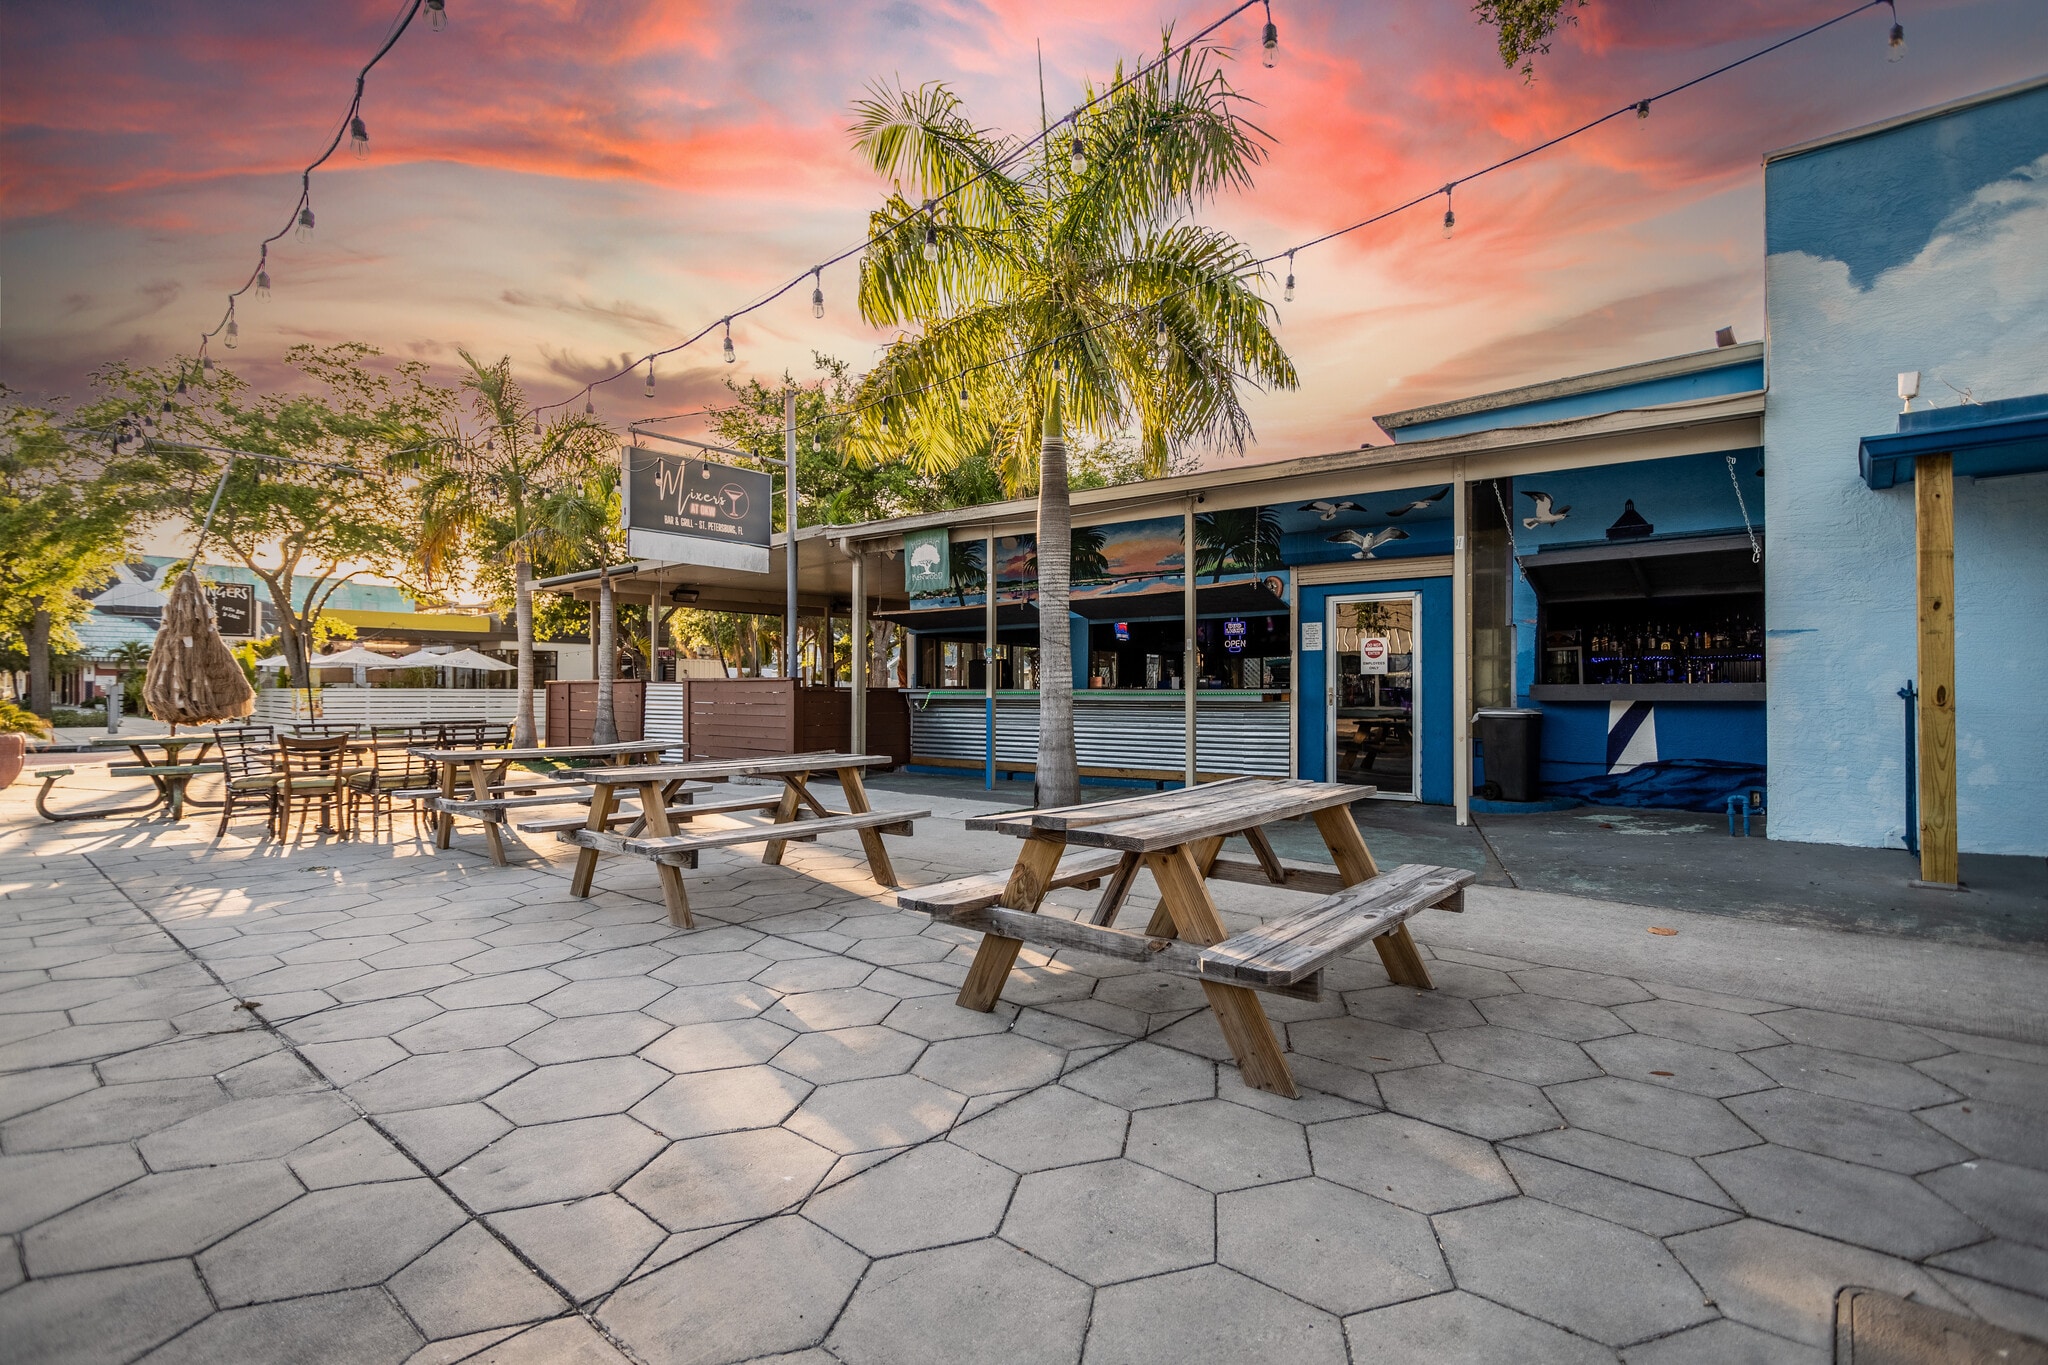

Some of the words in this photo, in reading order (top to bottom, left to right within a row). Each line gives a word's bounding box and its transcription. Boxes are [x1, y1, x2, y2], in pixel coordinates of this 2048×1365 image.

[660, 459, 726, 516] Mixers
[664, 515, 674, 525] BAR
[675, 516, 679, 526] &
[681, 517, 693, 528] GRILL
[699, 520, 707, 530] ST.
[738, 526, 743, 536] FL
[912, 571, 943, 582] KENWOOD
[203, 586, 248, 600] INGERS
[1224, 639, 1247, 648] OPEN
